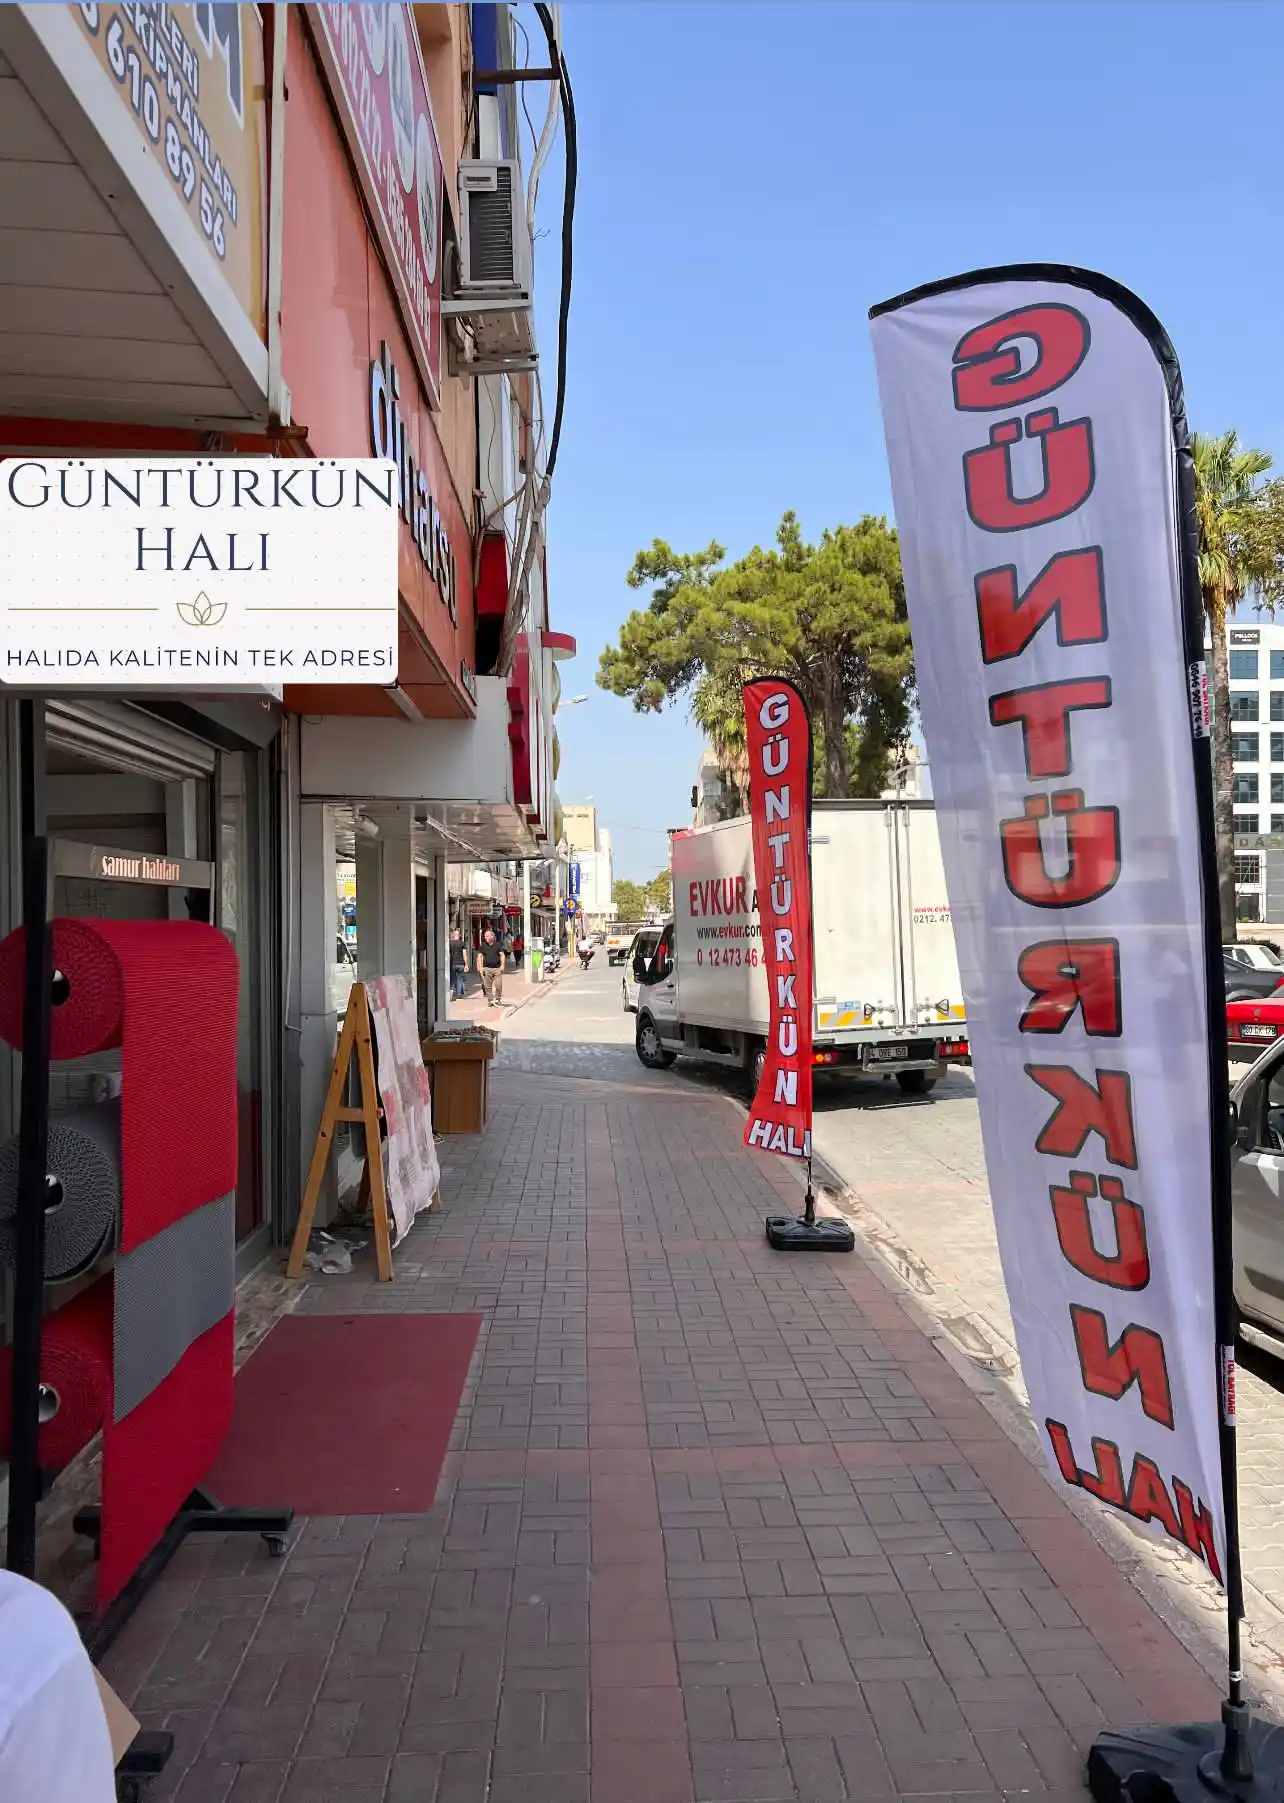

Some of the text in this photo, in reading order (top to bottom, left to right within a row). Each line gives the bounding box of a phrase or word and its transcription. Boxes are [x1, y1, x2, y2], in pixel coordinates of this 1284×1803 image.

[105, 14, 226, 261] 610 89 56
[102, 856, 141, 877] samur
[689, 876, 749, 917] EVKUR
[758, 692, 800, 1106] GÜNTÜRKÜN
[722, 948, 741, 968] 473
[745, 947, 758, 968] 46
[747, 1118, 812, 1158] HALI
